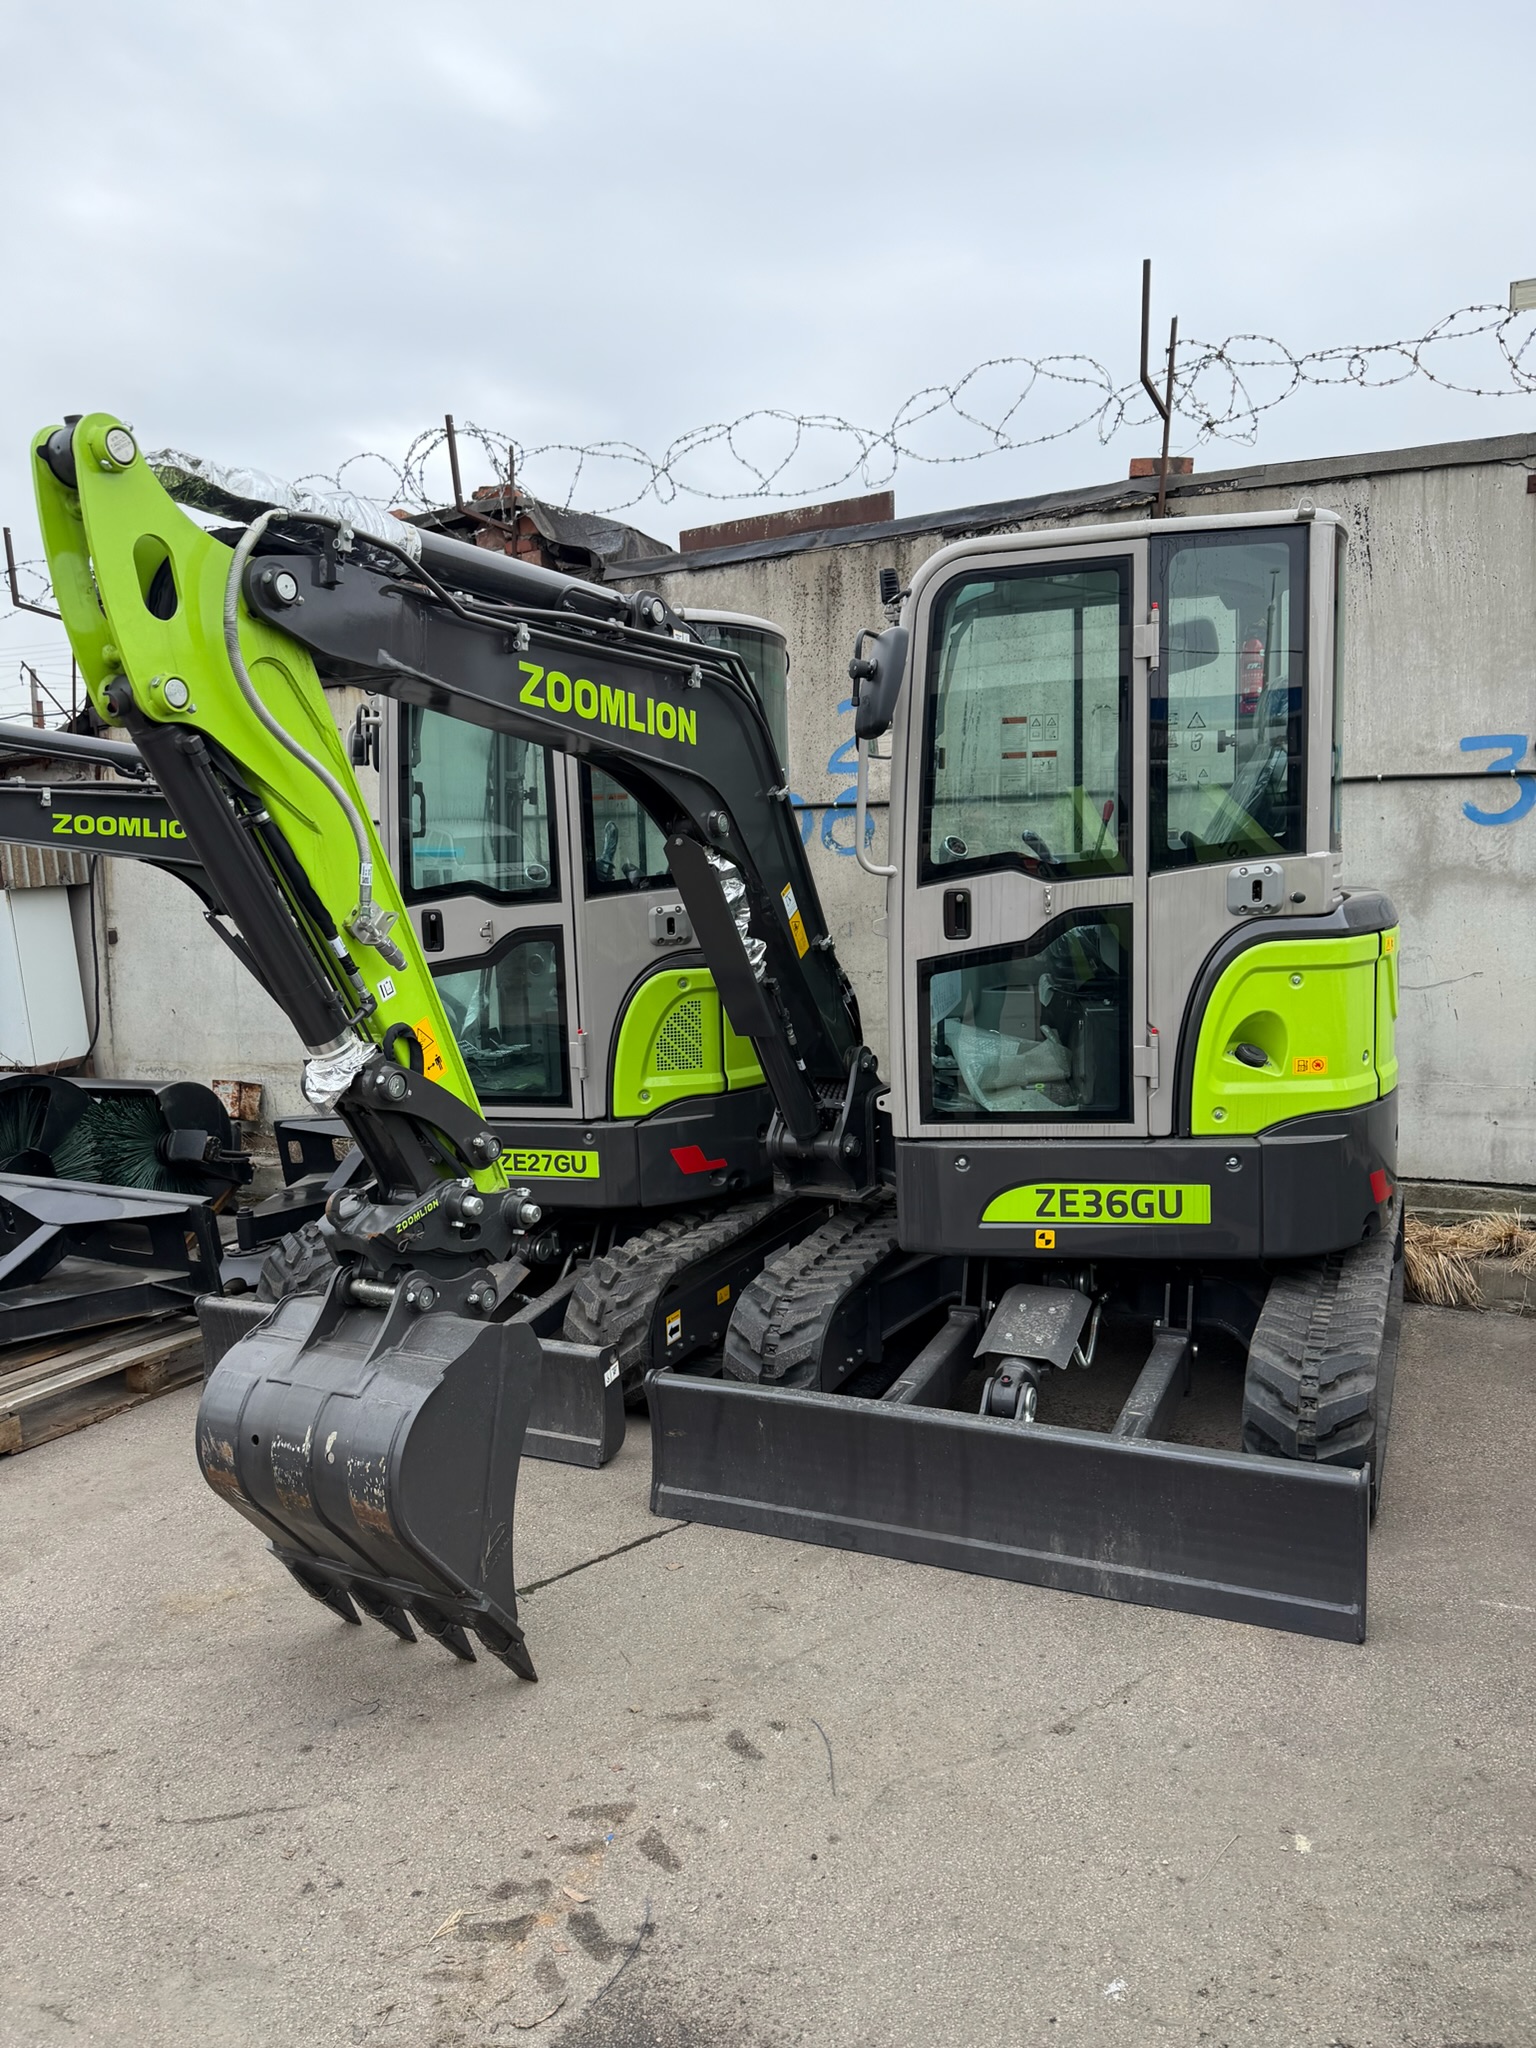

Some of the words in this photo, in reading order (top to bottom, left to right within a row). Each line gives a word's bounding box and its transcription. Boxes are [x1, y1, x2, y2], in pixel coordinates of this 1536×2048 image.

[518, 660, 697, 746] ZOOMLION
[1459, 733, 1536, 826] 3
[52, 813, 187, 839] ZOOMLIO
[502, 1153, 587, 1174] ZE27GU
[395, 1198, 440, 1235] ZOOMLION
[1035, 1188, 1183, 1219] ZE36GU
